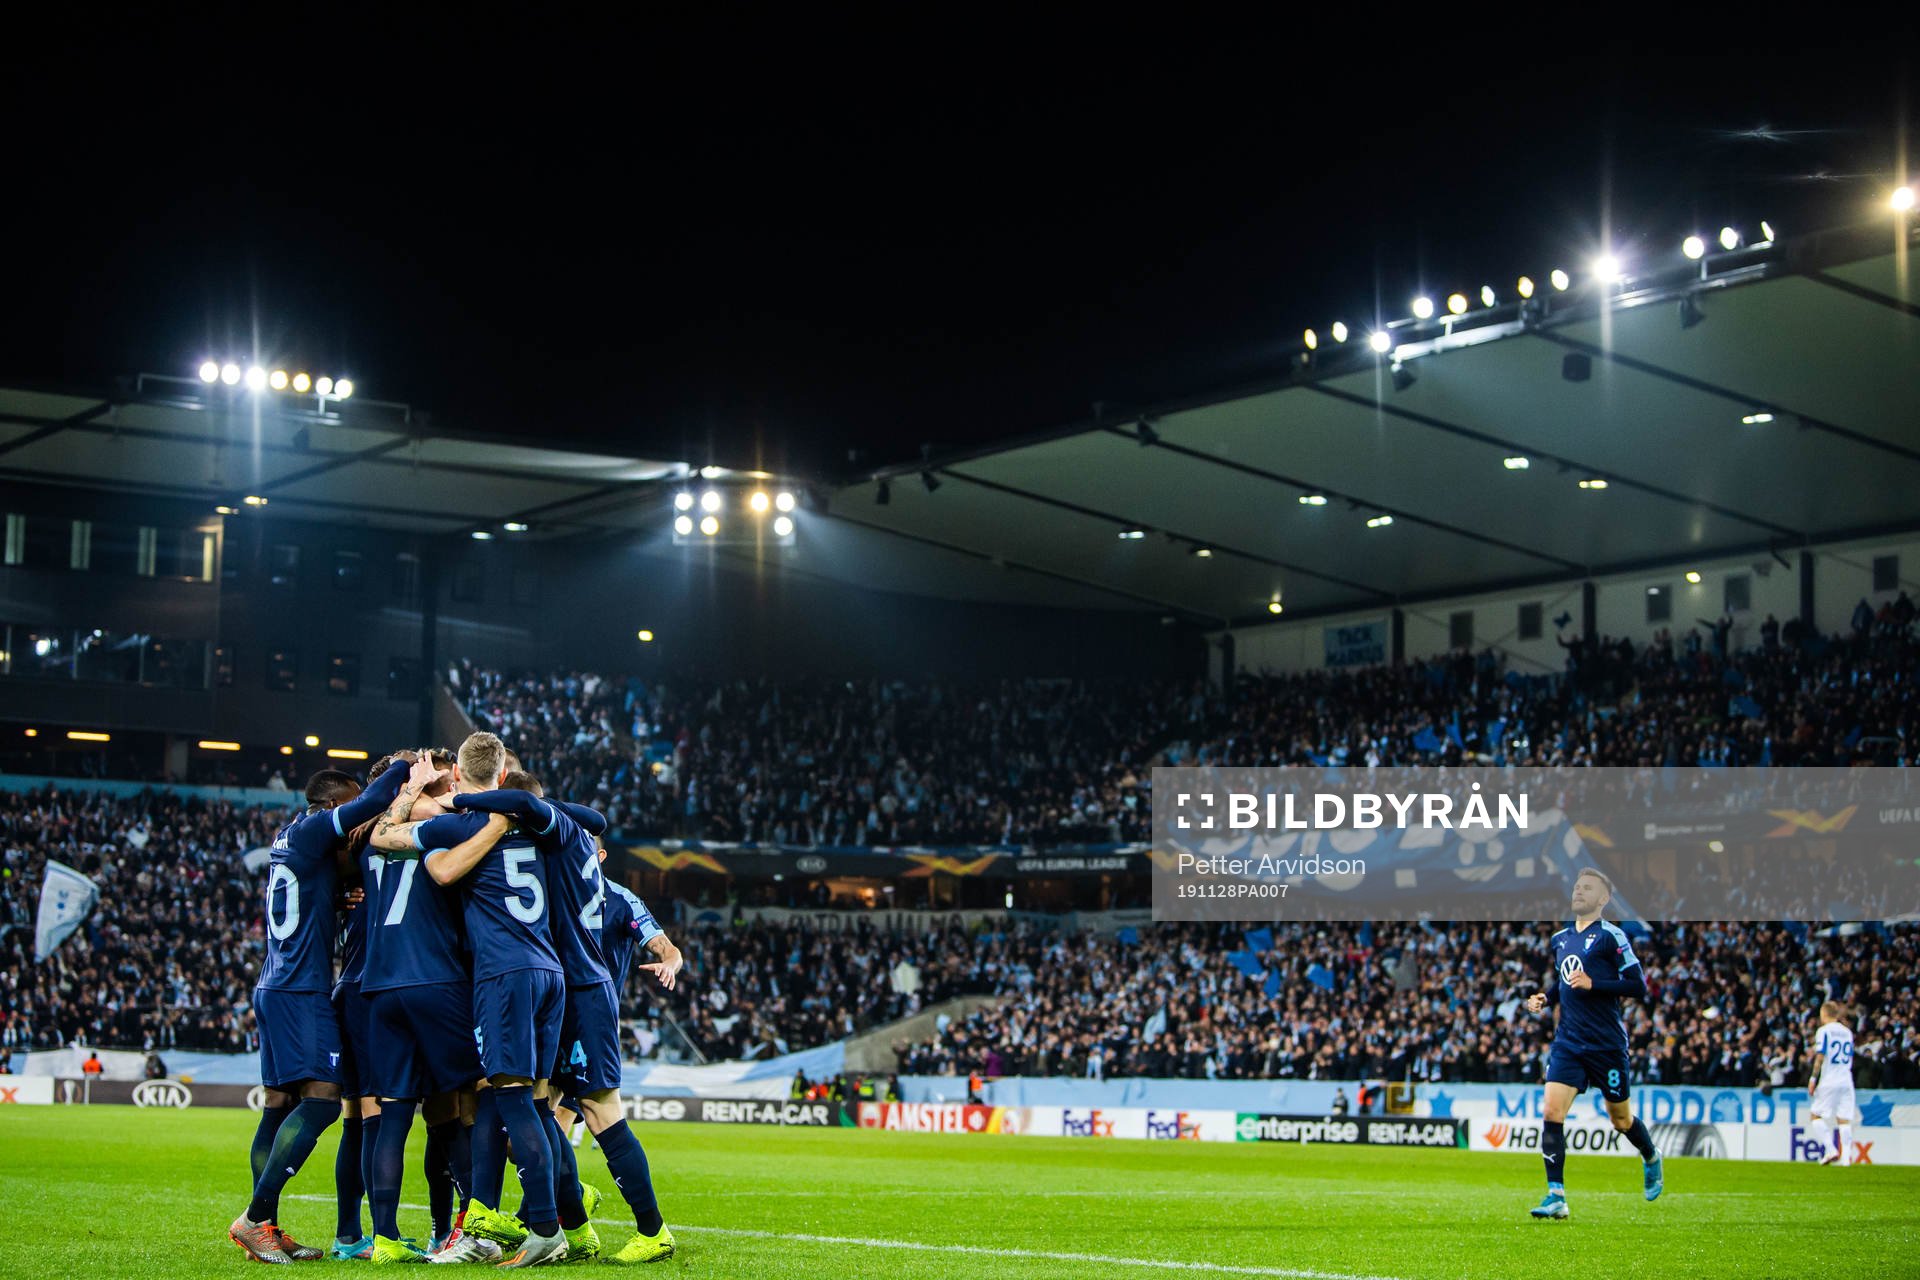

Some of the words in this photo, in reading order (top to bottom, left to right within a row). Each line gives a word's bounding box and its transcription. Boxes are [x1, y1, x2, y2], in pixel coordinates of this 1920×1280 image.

[1879, 807, 1912, 824] UEFA
[368, 854, 419, 927] 17
[502, 846, 545, 924] 5
[1831, 1040, 1851, 1065] 29
[1607, 1069, 1621, 1088] 8
[138, 1083, 186, 1107] KIA
[702, 1101, 829, 1125] RENT-A-CAR
[884, 1102, 968, 1133] AMSTEL
[1063, 1110, 1115, 1137] FedEx
[1146, 1111, 1202, 1140] FedEx
[1239, 1116, 1359, 1145] enterprise
[1368, 1122, 1455, 1146] RENT-A-CAR
[1790, 1127, 1873, 1164] Fex
